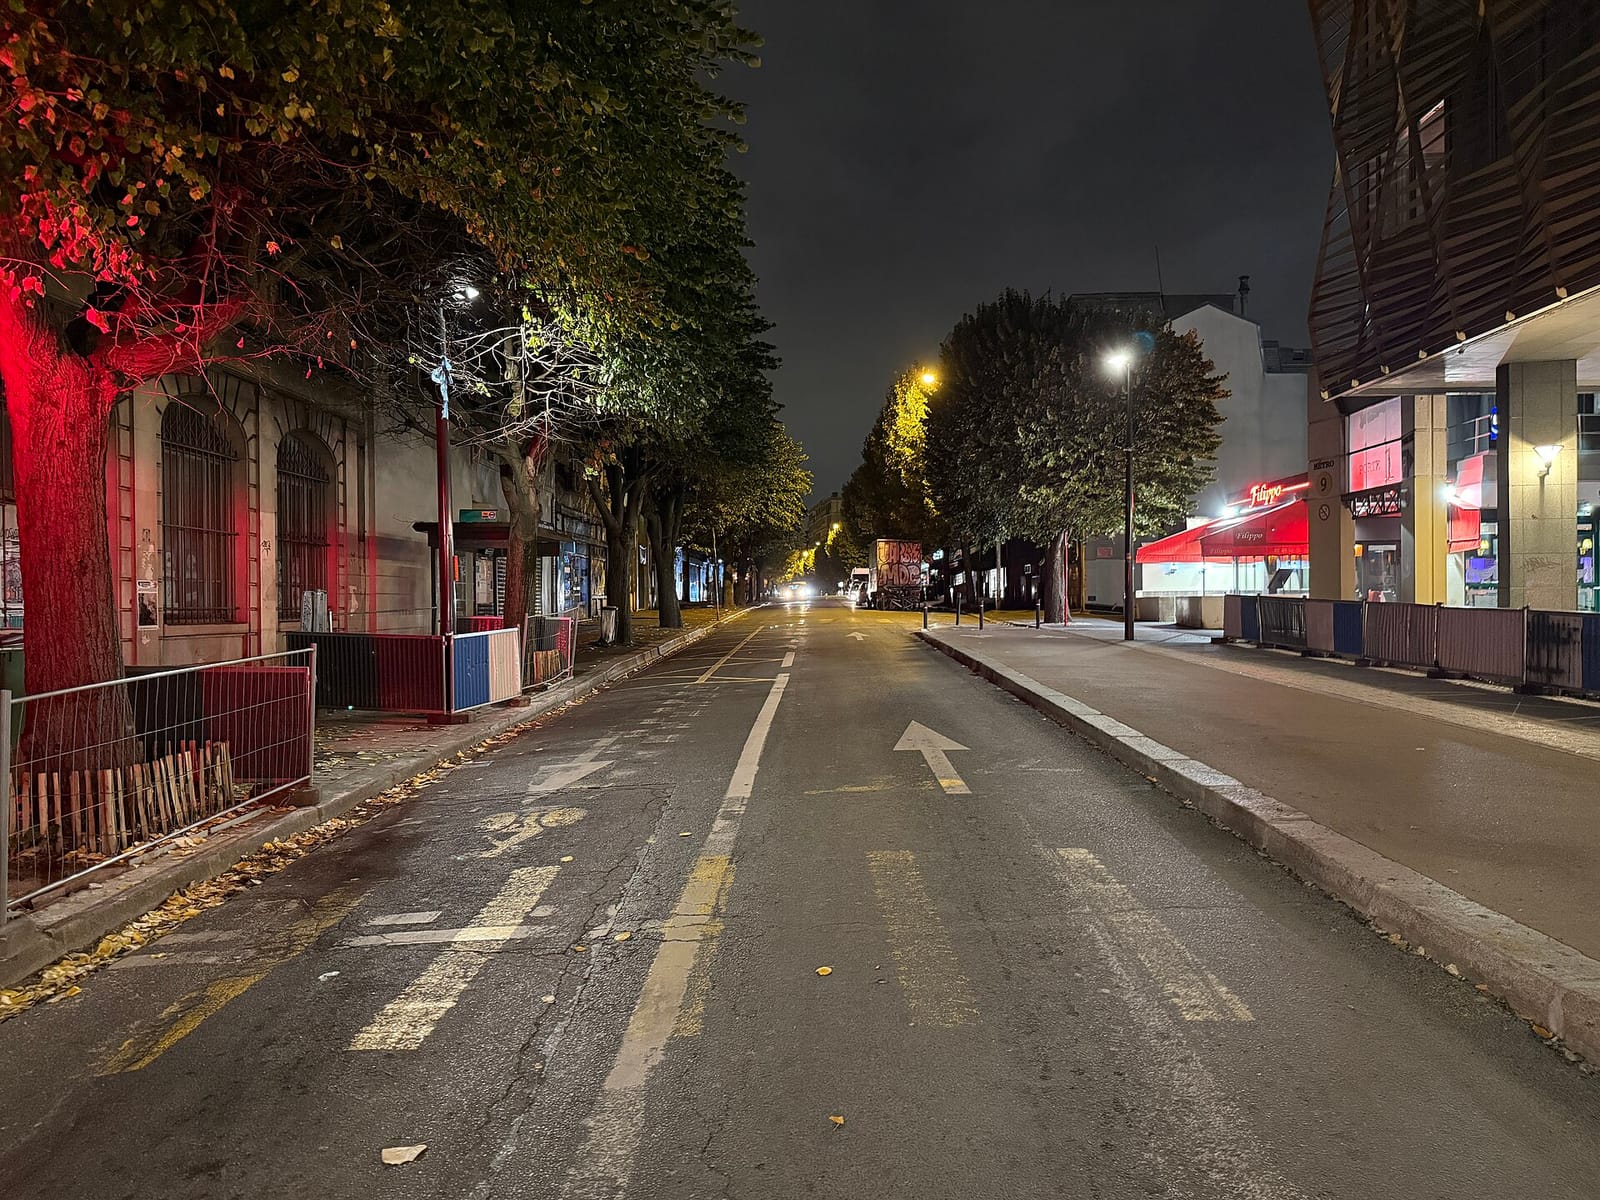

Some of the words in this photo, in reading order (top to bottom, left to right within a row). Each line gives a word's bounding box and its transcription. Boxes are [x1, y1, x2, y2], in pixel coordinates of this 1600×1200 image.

[1320, 477, 1327, 491] 9
[1248, 483, 1282, 508] Filippo
[1236, 532, 1263, 541] Filippo
